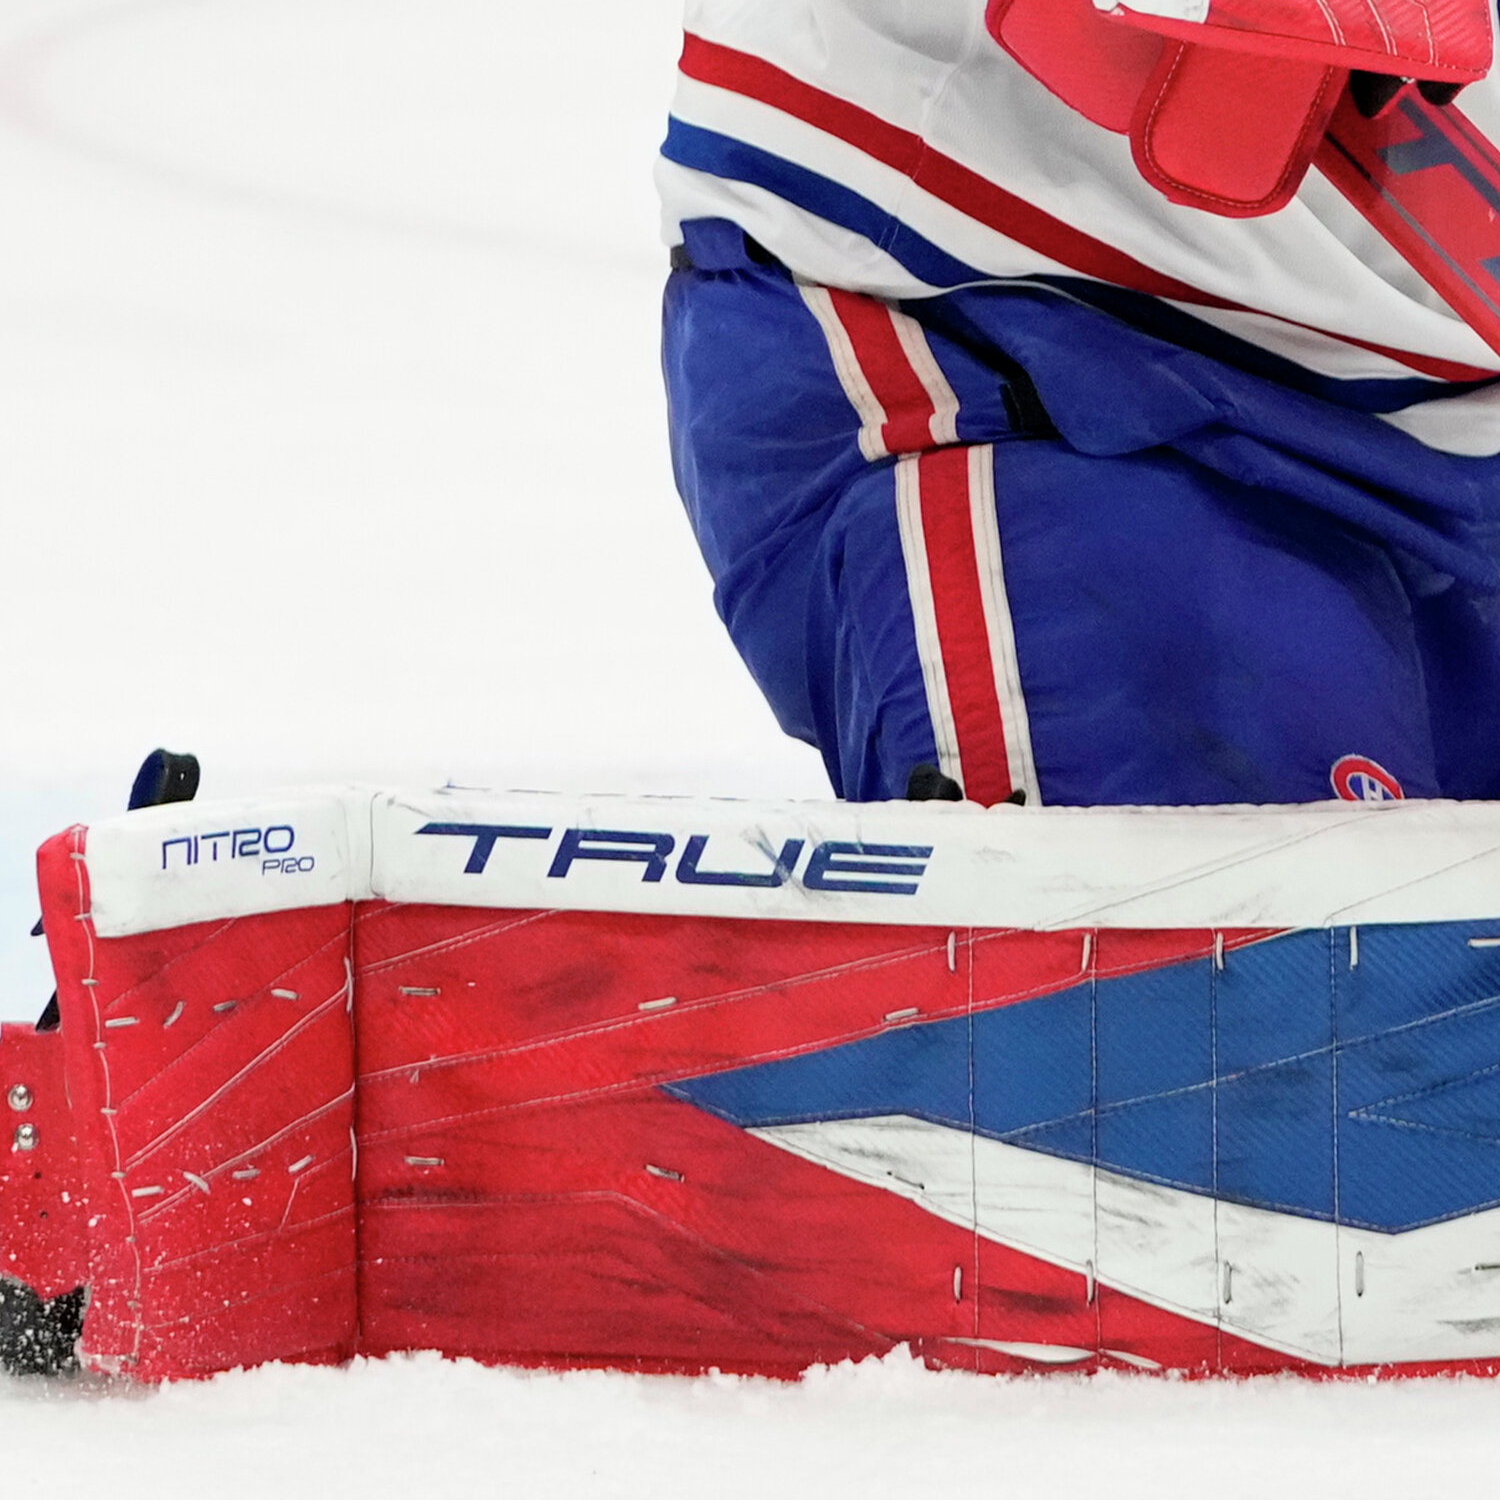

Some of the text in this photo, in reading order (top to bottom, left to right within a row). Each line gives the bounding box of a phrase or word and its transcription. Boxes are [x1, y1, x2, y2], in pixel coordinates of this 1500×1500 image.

[162, 825, 295, 870] NITRO
[262, 856, 316, 876] PRO
[413, 822, 934, 896] TRUE
